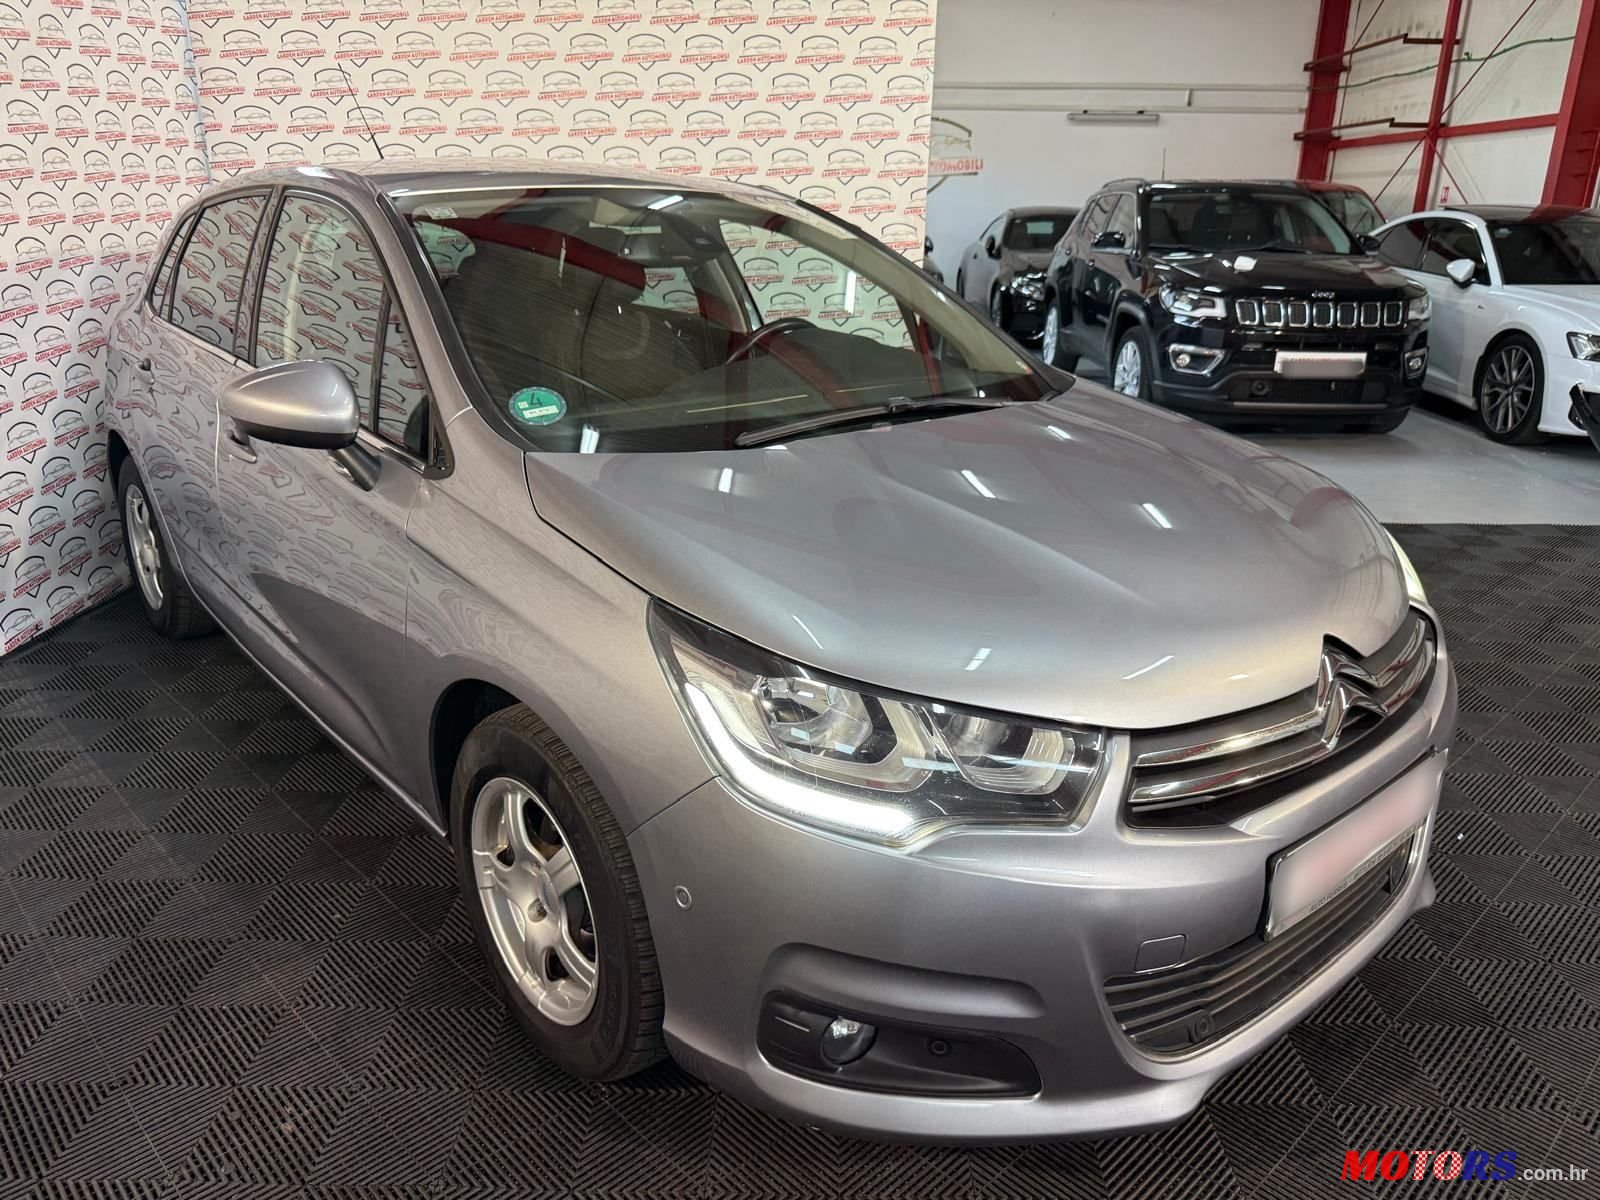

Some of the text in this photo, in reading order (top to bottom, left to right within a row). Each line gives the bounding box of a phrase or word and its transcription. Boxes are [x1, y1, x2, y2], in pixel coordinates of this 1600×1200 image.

[902, 17, 933, 26] AUTOMOBILI
[900, 94, 929, 103] AUTOMOBILI
[896, 168, 926, 177] AUTOMOBILI
[868, 203, 896, 213] AUTOMOBILI
[1312, 291, 1335, 299] Jeep
[530, 392, 543, 406] 4
